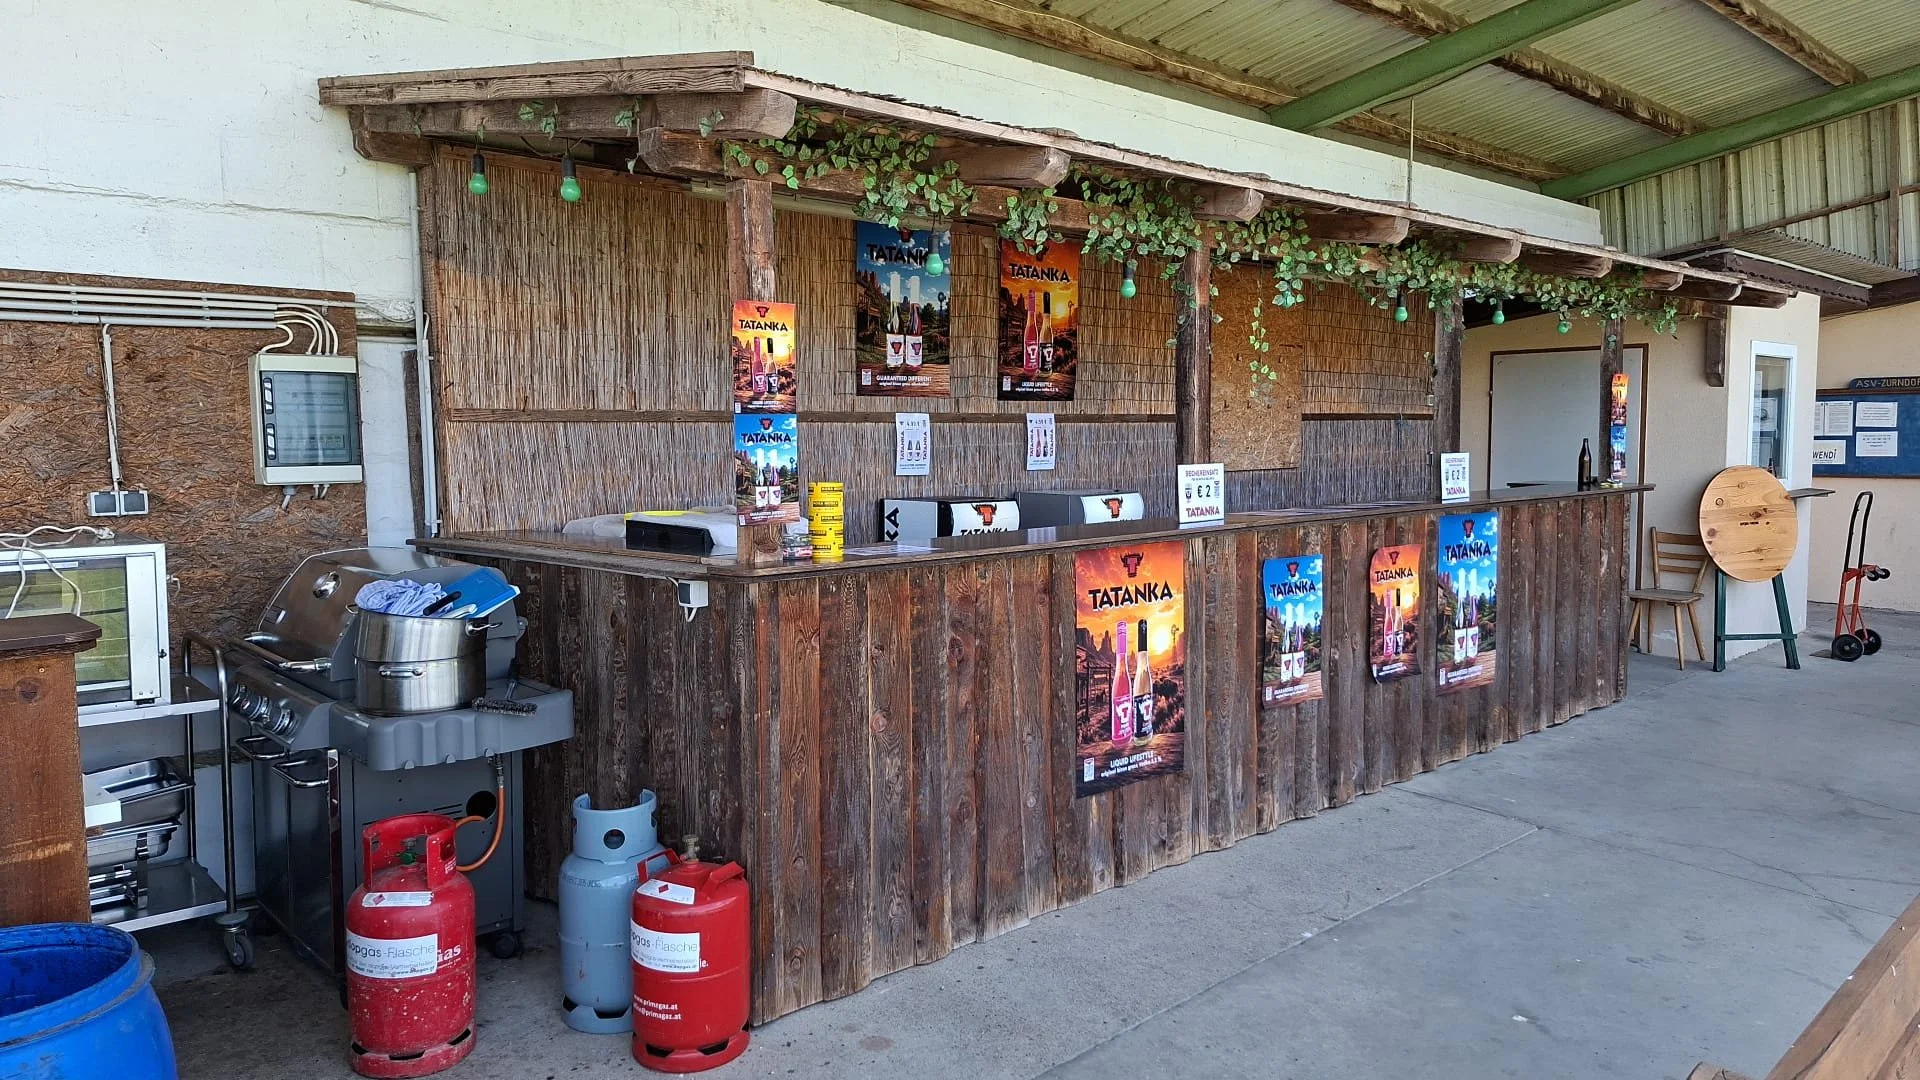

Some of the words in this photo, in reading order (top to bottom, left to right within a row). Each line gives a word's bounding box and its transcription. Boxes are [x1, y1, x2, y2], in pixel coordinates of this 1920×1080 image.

[866, 243, 929, 266] TATANK
[1009, 263, 1071, 283] TATANKA
[739, 319, 788, 332] TATANKA
[741, 432, 792, 443] TATANKA
[1197, 485, 1203, 498] €
[1206, 485, 1211, 497] 2
[1446, 486, 1466, 496] TATANKA
[1186, 506, 1220, 518] TATANKA
[1445, 541, 1492, 561] TATANKA
[1375, 567, 1414, 583] TATANKA
[1088, 581, 1173, 611] TATANKA
[1270, 580, 1316, 598] TATANKA
[1110, 757, 1129, 768] LIQUID
[1129, 750, 1154, 763] LIFESTYLE
